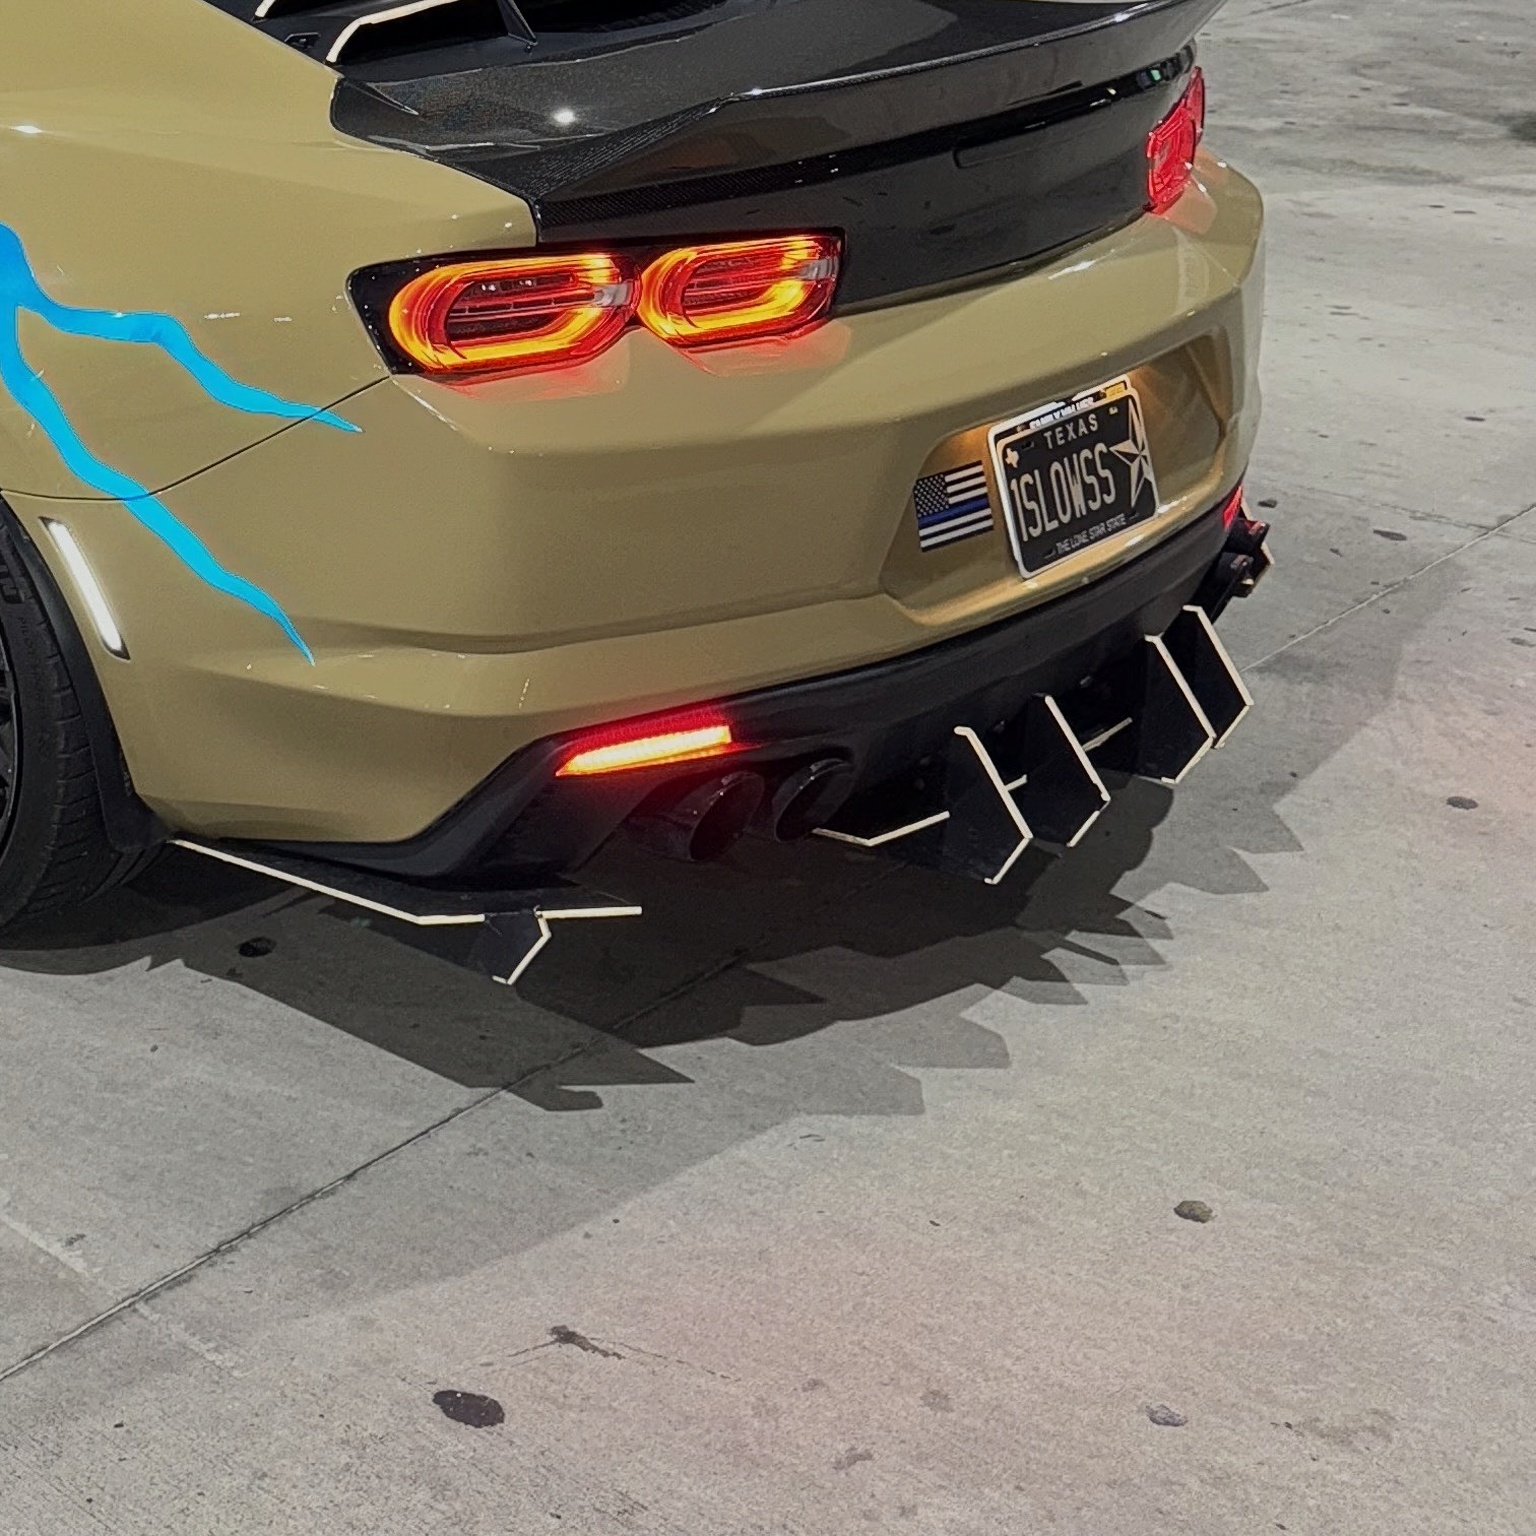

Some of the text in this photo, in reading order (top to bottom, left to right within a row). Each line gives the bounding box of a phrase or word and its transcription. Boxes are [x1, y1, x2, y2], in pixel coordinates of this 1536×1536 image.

[1043, 413, 1098, 449] TEXAS
[1010, 442, 1116, 542] 1SLOWSS
[1069, 530, 1089, 548] LONE
[1088, 522, 1107, 540] STAR
[1106, 512, 1127, 532] STATE
